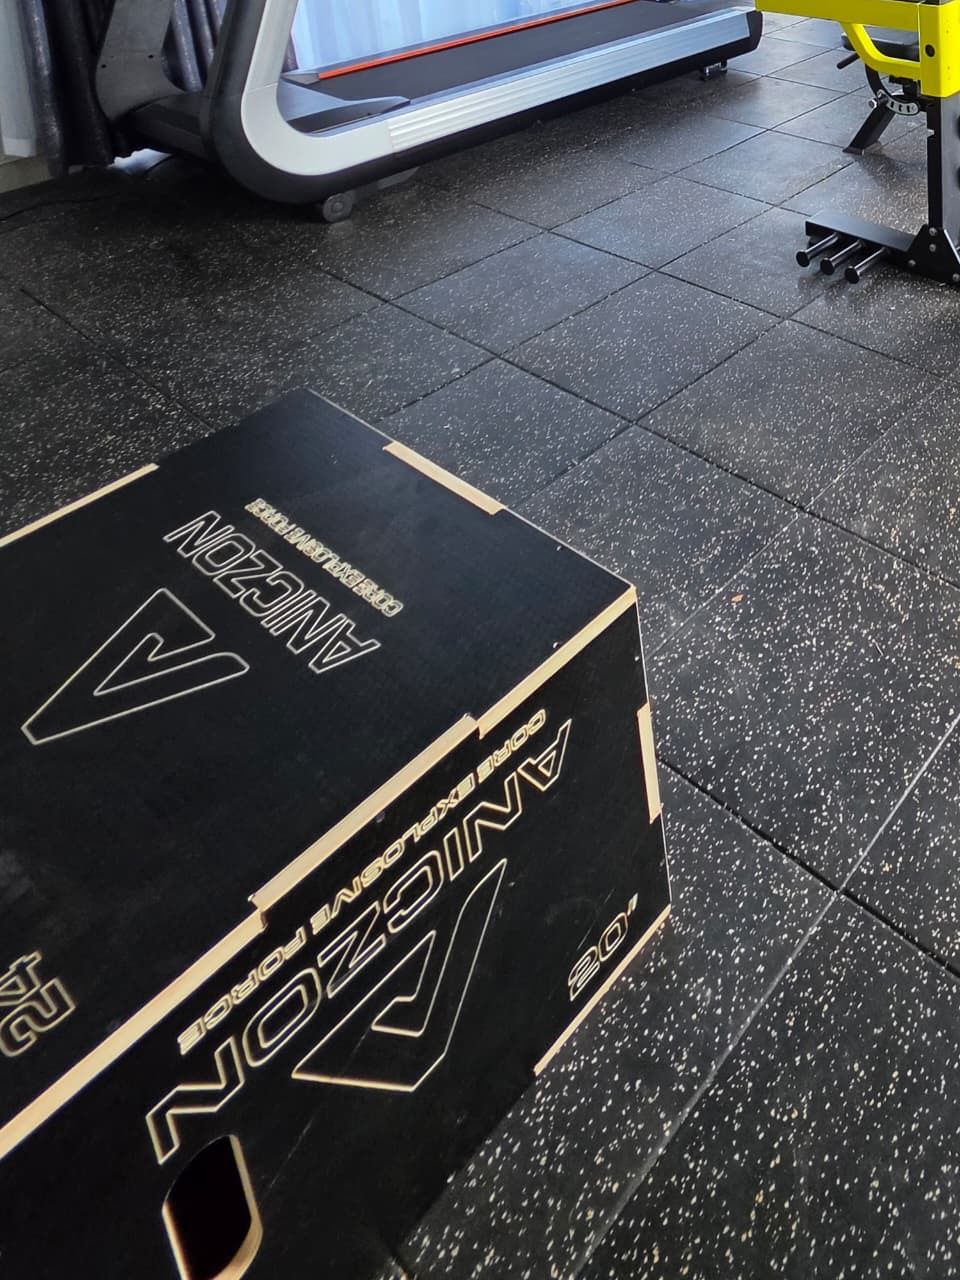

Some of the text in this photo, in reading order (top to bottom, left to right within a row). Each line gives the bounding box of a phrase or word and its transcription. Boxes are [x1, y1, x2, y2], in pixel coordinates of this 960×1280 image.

[163, 510, 382, 674] ANICZON
[244, 498, 404, 617] CORE EXPLOSIVE FORCE
[145, 718, 573, 1166] ANICZON
[177, 709, 546, 1055] CORE EXPLOSIVE FORCE
